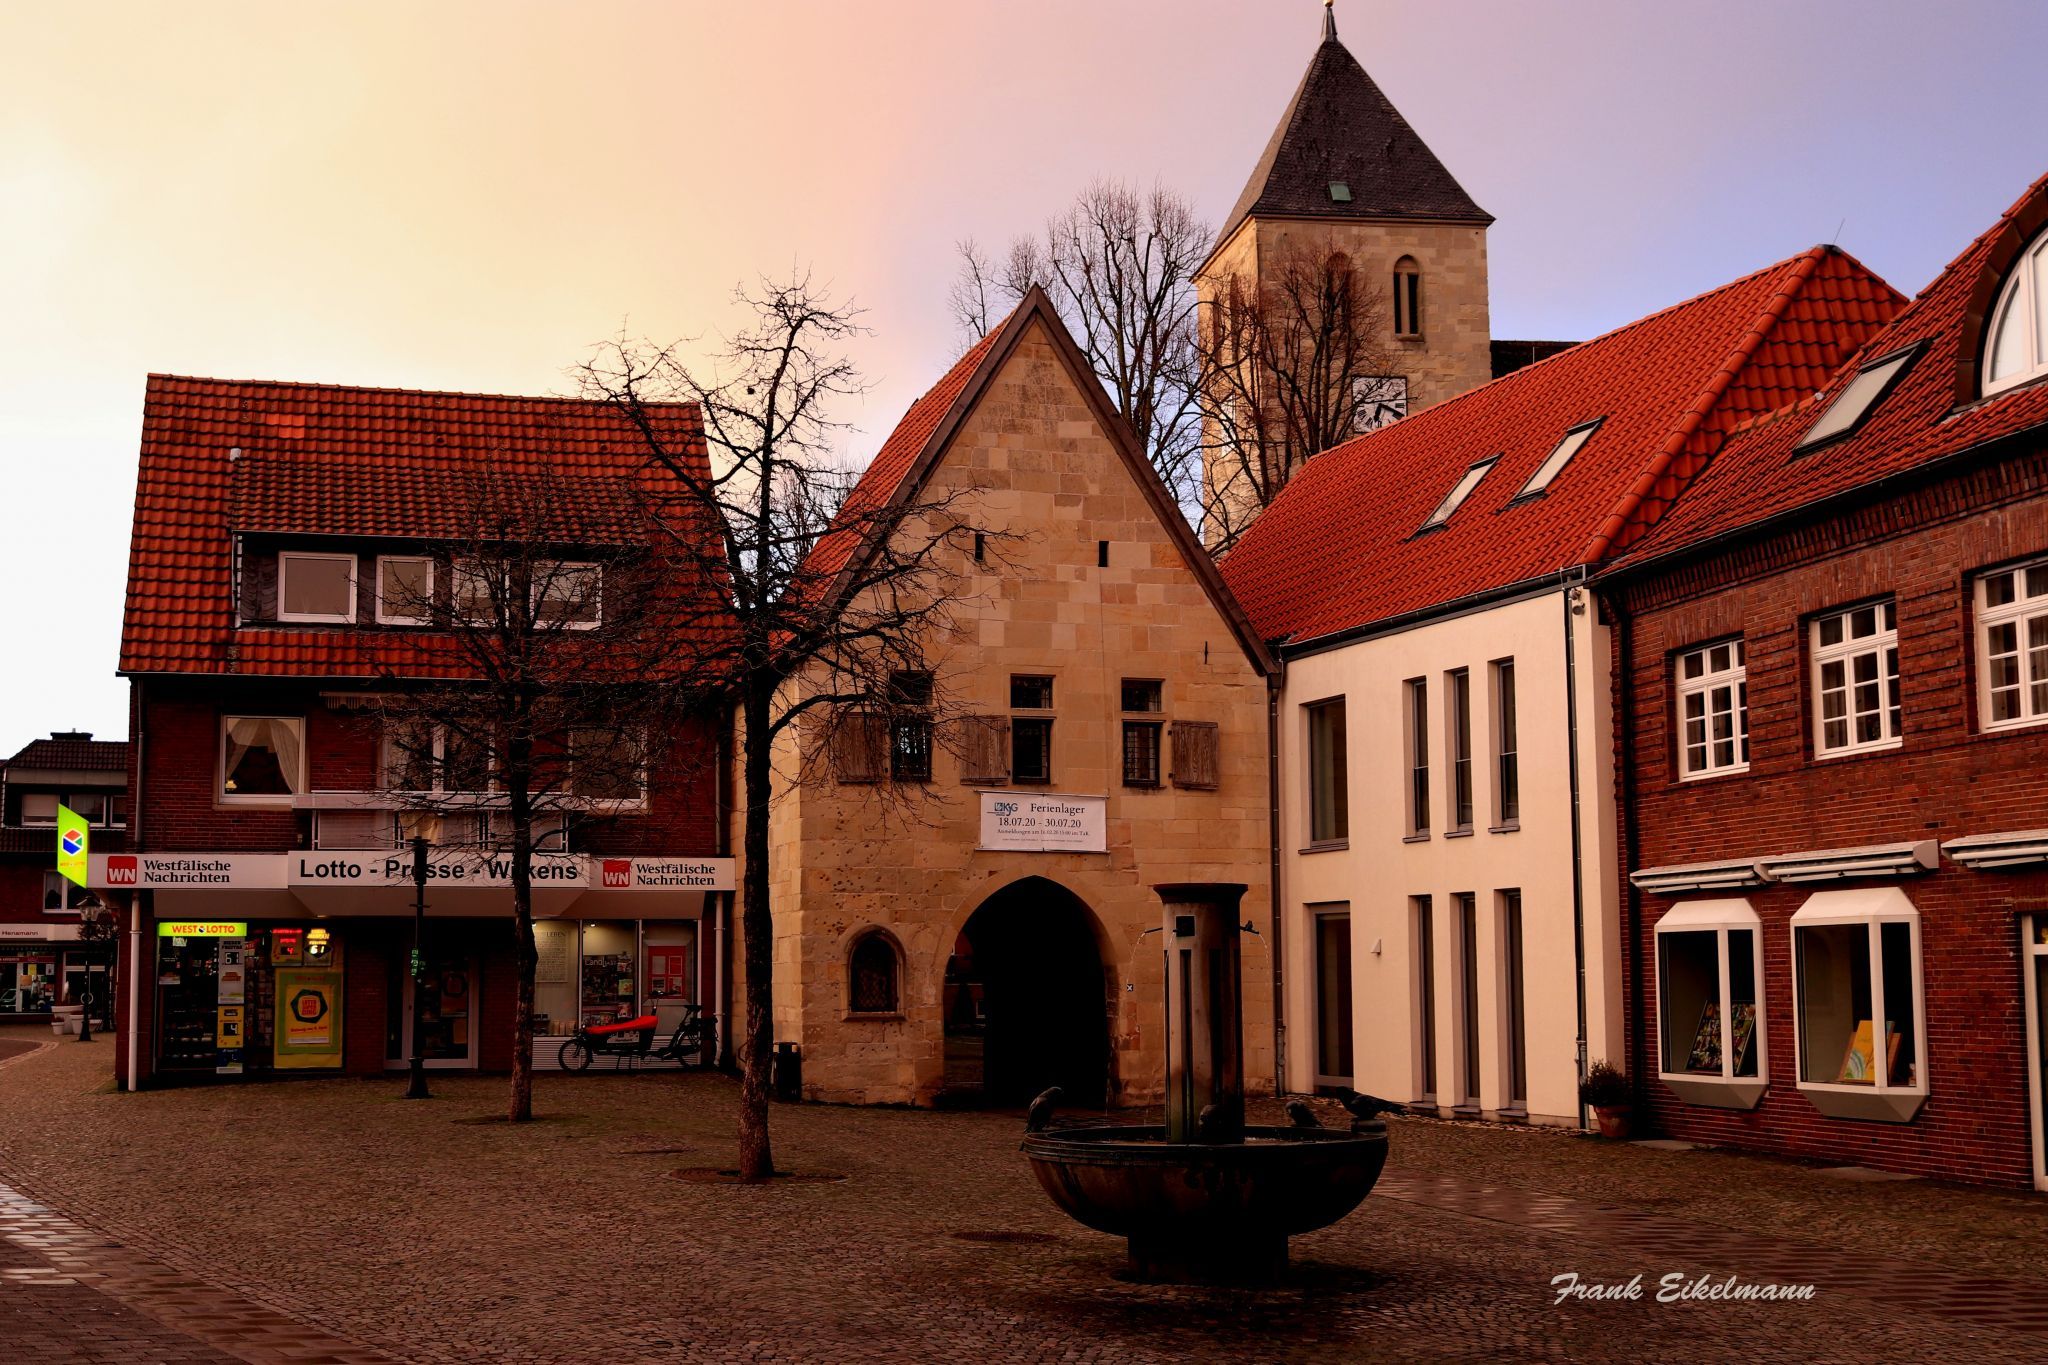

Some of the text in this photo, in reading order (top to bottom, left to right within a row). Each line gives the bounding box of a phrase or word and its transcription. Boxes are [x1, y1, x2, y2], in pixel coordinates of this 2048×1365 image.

[1030, 803, 1085, 816] Ferienlager
[999, 817, 1036, 827] 18.07.20
[1044, 818, 1082, 828] 30.07.20
[144, 860, 231, 871] Westfälische
[300, 859, 362, 878] Lotto
[488, 860, 578, 879] Wikens
[636, 864, 716, 874] Westfälische
[108, 868, 136, 882] WN
[144, 872, 230, 883] Nachrichten
[604, 872, 629, 885] WN
[637, 875, 715, 886] Nachrichten
[172, 925, 235, 933] WEST LOTTO
[225, 952, 239, 964] 61
